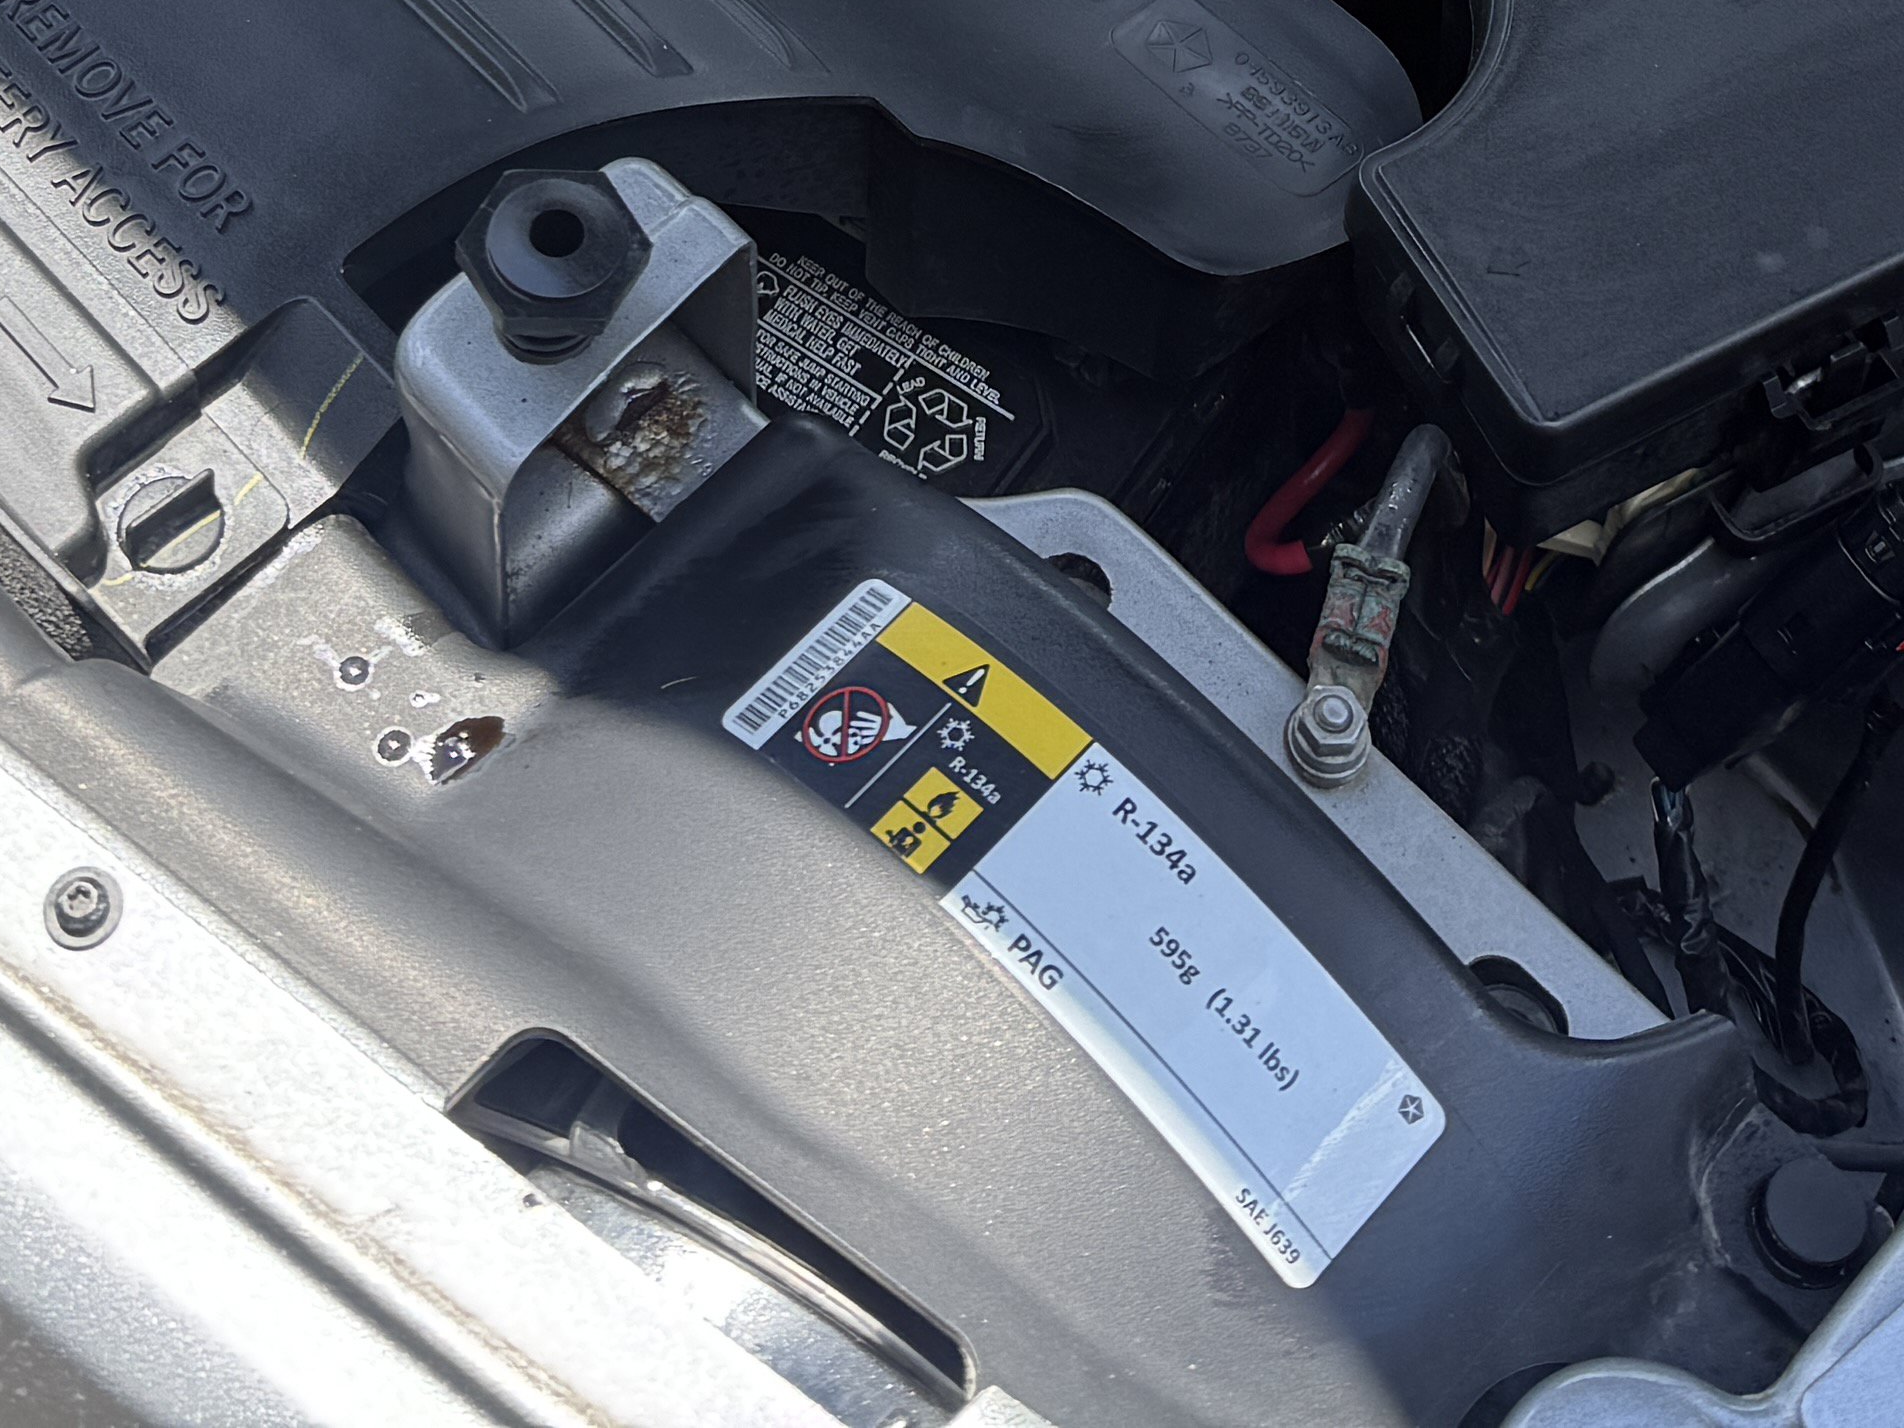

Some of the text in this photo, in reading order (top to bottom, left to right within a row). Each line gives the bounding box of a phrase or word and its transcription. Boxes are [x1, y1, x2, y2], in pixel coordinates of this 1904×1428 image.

[151, 140, 257, 237] FOR
[51, 161, 226, 326] ACCESS
[763, 309, 862, 378] MEDICAL HELP FAST
[769, 252, 787, 269] DO
[787, 263, 812, 284] NOT
[885, 326, 916, 351] CAPS
[945, 364, 972, 387] AND
[774, 299, 802, 323] WITH
[837, 337, 861, 358] GET
[782, 284, 909, 370] FLUSH EYES IMMEDIATELY
[825, 272, 850, 294] OUT
[848, 287, 865, 303] OF
[864, 297, 888, 318] THE
[886, 311, 923, 340] REACH
[921, 333, 939, 350] OF
[936, 343, 991, 382] CHILDREN
[775, 342, 801, 363] SAFE
[824, 373, 872, 408] STARTING
[786, 377, 809, 398] NOT
[809, 377, 822, 392] IN
[821, 385, 860, 415] VEHICLE
[776, 619, 885, 723] P68253844AA
[946, 754, 1003, 806] R-134a
[1110, 795, 1200, 888] R-134a
[1006, 932, 1066, 994] PAG
[1145, 925, 1302, 1095] 595g (1.31 lbs)
[1232, 1184, 1304, 1268] SAE J639
